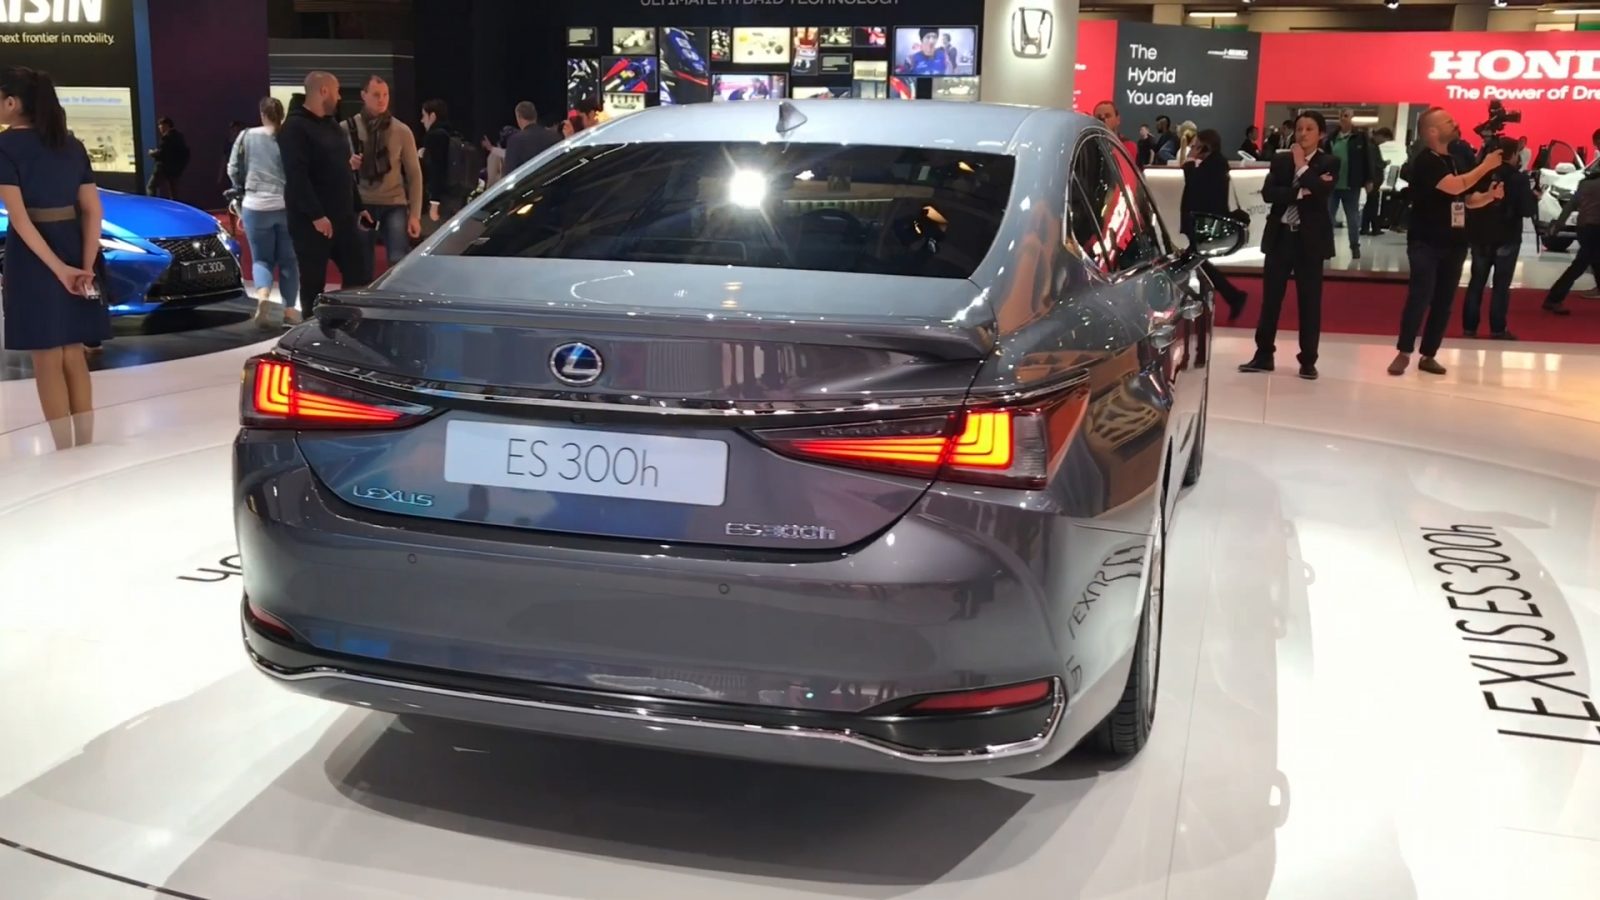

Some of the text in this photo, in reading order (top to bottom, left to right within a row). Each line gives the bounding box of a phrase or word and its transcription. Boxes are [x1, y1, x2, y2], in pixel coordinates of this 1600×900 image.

[0, 0, 102, 23] ISIN
[22, 32, 59, 43] frontier
[61, 33, 72, 43] in
[1129, 44, 1158, 60] The
[1128, 66, 1176, 86] Hybrid
[1126, 89, 1213, 107] You can feel
[1446, 85, 1480, 100] The
[1483, 85, 1545, 100] Power
[1547, 85, 1569, 100] of
[506, 438, 659, 488] ES 300h
[353, 485, 433, 507] LEXUS
[1420, 524, 1600, 746] LEXUS ES 300h
